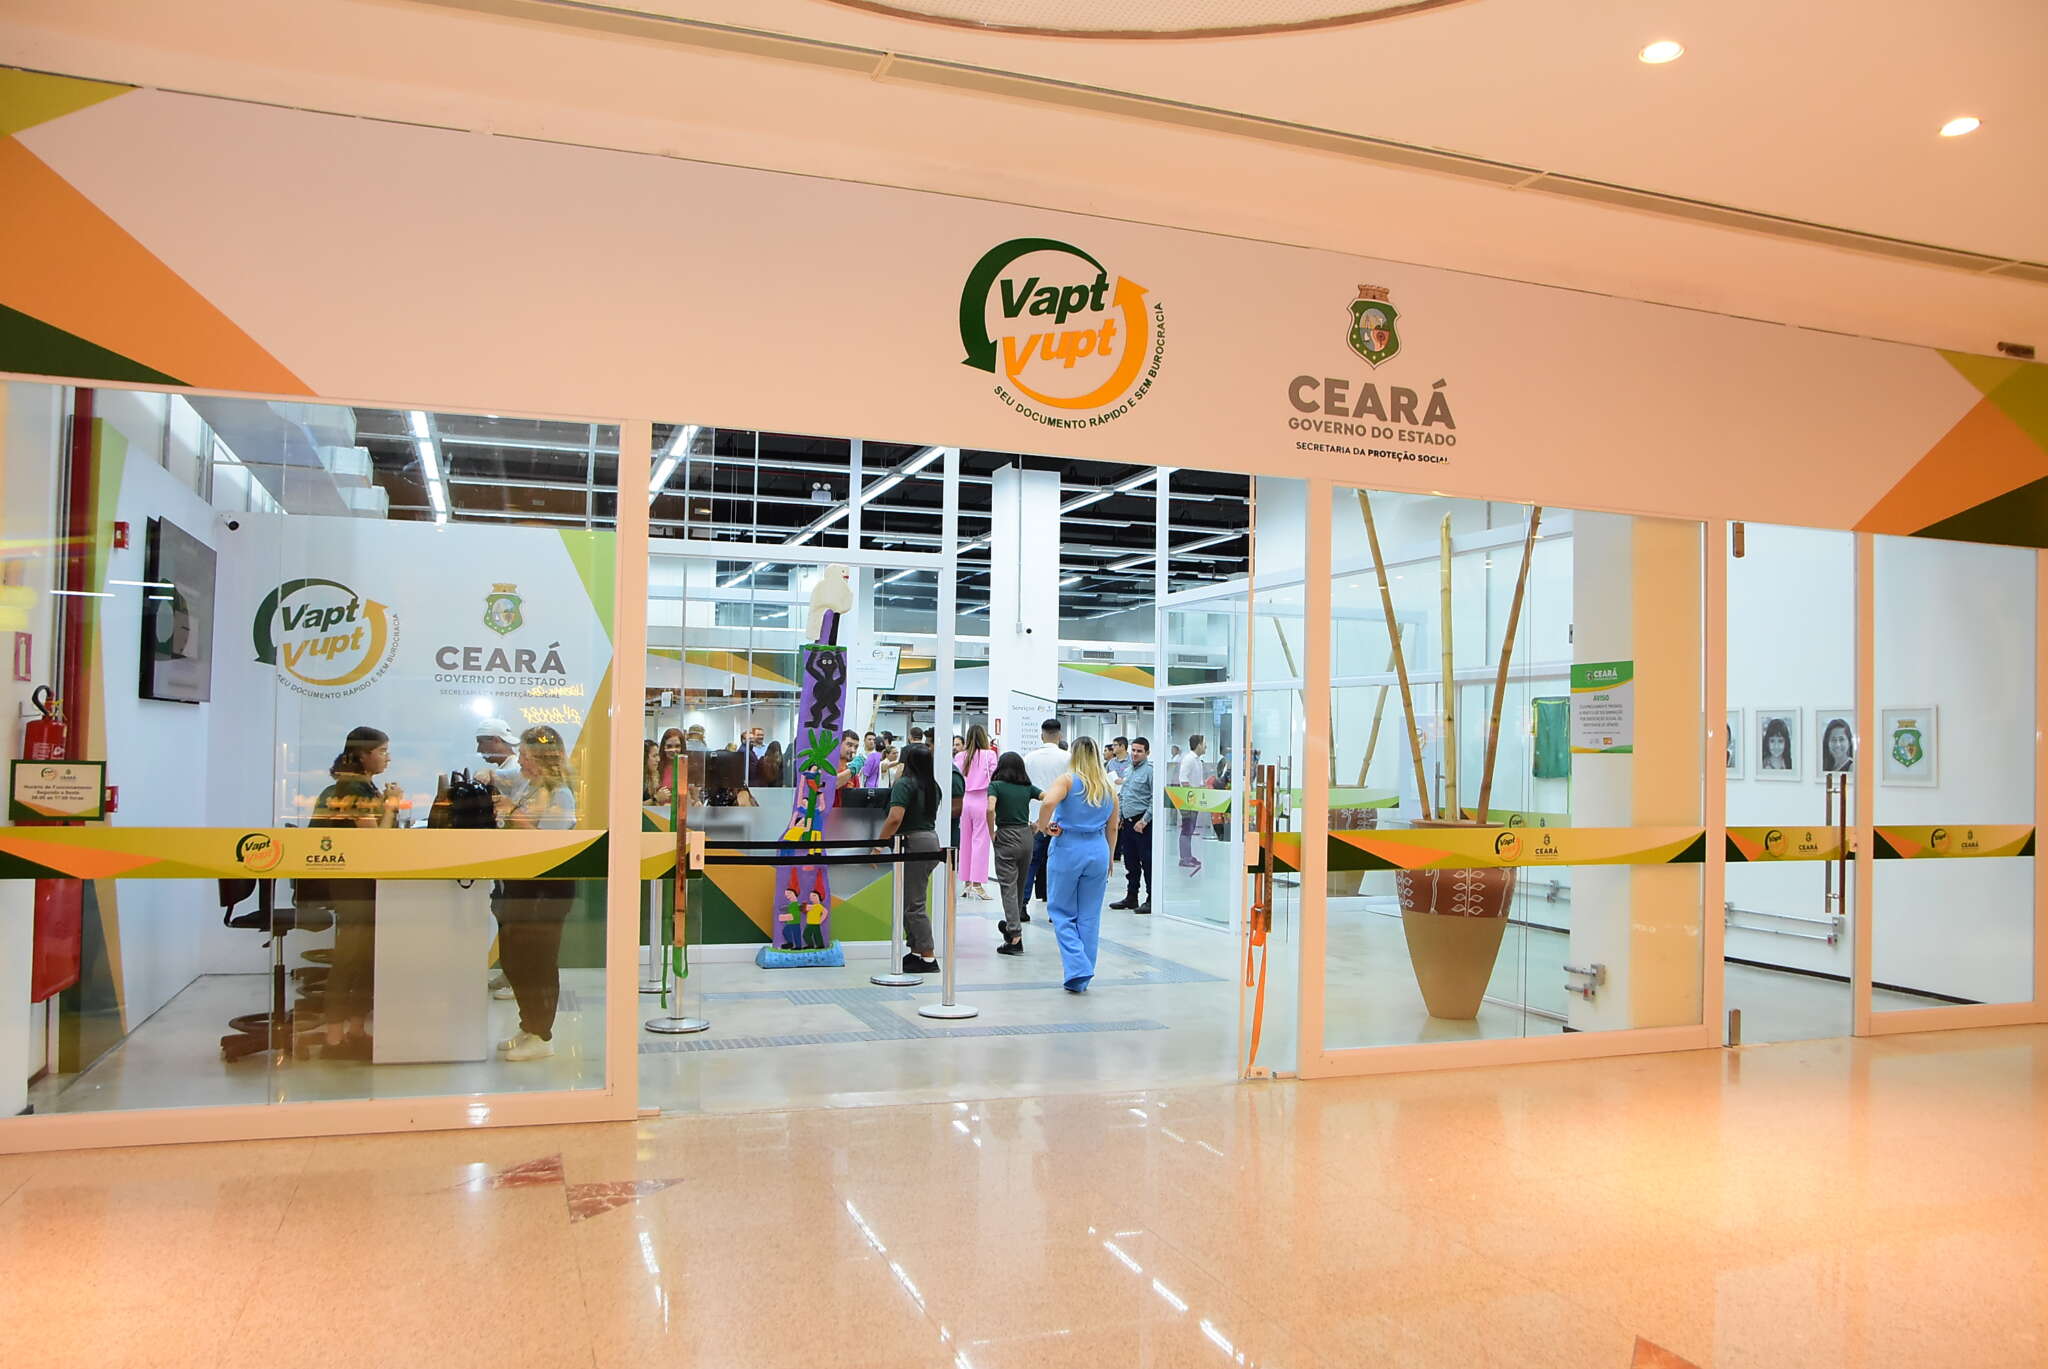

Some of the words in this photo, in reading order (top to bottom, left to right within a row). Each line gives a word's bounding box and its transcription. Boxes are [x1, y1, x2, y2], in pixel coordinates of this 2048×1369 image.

[1000, 272, 1109, 324] Vapt
[1002, 318, 1117, 376] Vupt
[994, 385, 1015, 406] SEU
[1015, 403, 1087, 429] DOCUMENTO
[1089, 404, 1128, 427] RÁPIDO
[1127, 397, 1137, 408] E
[1134, 378, 1153, 400] SEM
[1148, 301, 1166, 378] BUROCRACIA
[1288, 375, 1457, 430] CEARÁ
[1288, 417, 1367, 437] GOVERNO
[1371, 426, 1394, 440] DO
[1398, 429, 1457, 447] ESTADO
[1296, 441, 1351, 454] SECRETARIA
[1353, 447, 1366, 456] DA
[1367, 449, 1416, 462] PROTEÇÃO
[282, 598, 360, 633] Vapt
[282, 626, 365, 668] Vupt
[435, 641, 566, 675] CEARÁ
[291, 684, 341, 699] DOCUMENTO
[376, 663, 390, 678] SEM
[435, 673, 495, 685] GOVERNO
[498, 675, 517, 686] DO
[520, 676, 567, 687] ESTADO
[1593, 667, 1617, 678] CEARÁ
[245, 839, 271, 851] Vapt
[306, 852, 346, 863] CEARÁ
[1535, 846, 1558, 855] CEARÁ
